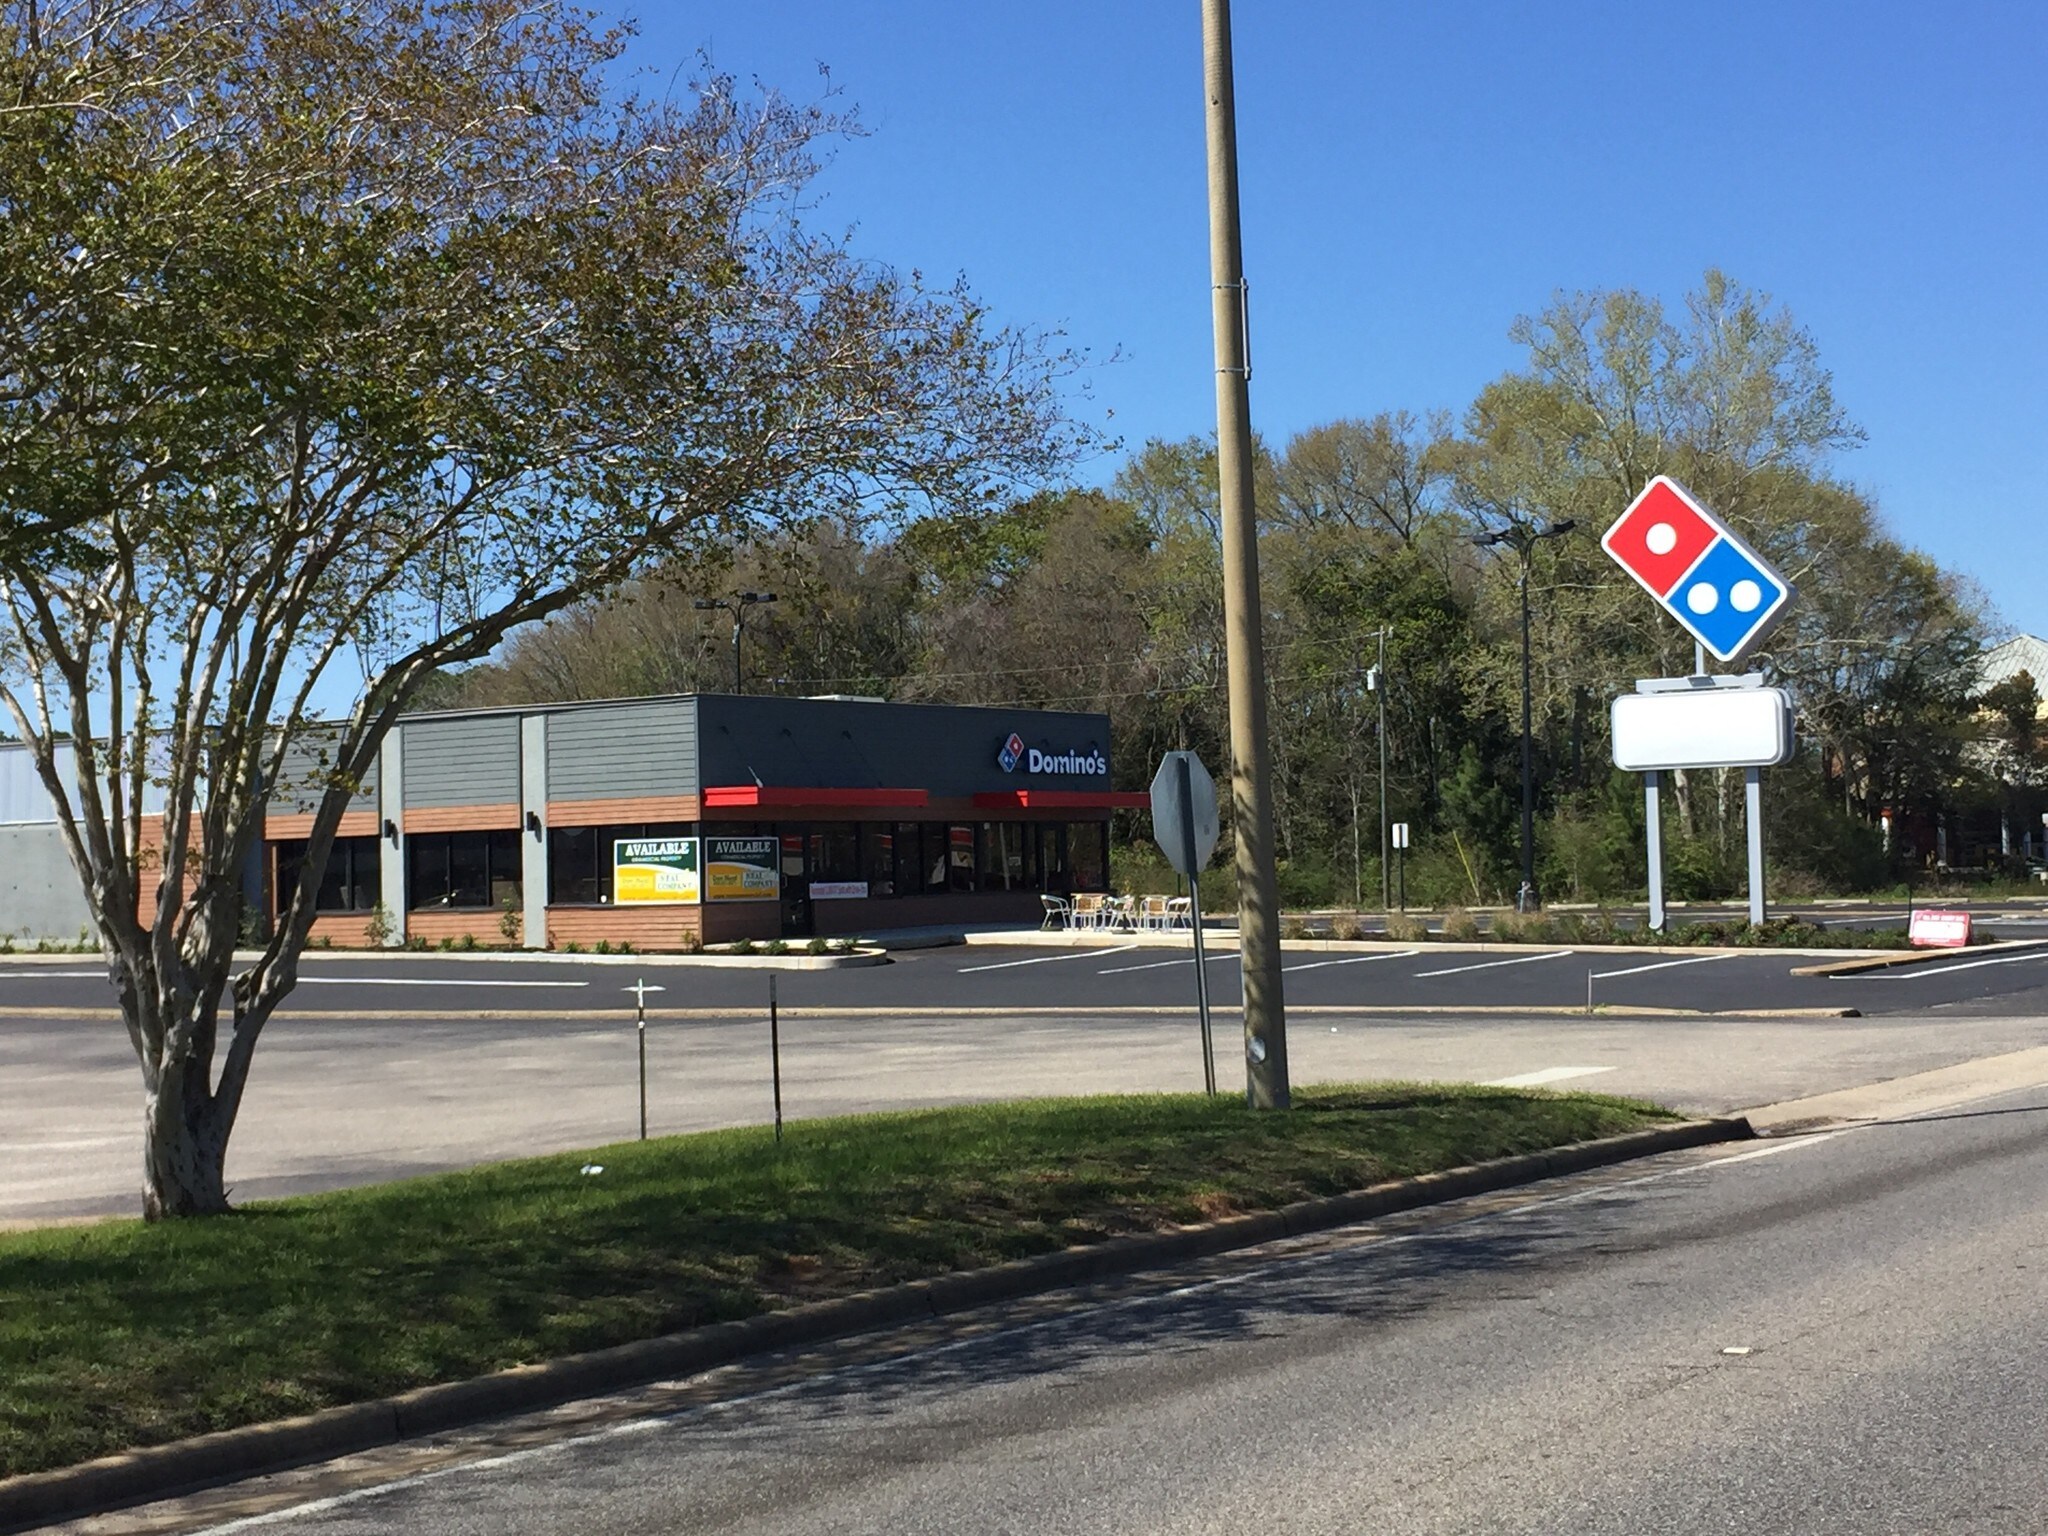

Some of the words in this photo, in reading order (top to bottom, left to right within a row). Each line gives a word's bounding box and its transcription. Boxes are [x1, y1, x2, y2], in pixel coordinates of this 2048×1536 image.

[1028, 749, 1106, 774] Domino's
[625, 842, 690, 856] AVAILABLE
[715, 841, 771, 853] AVAILABLE
